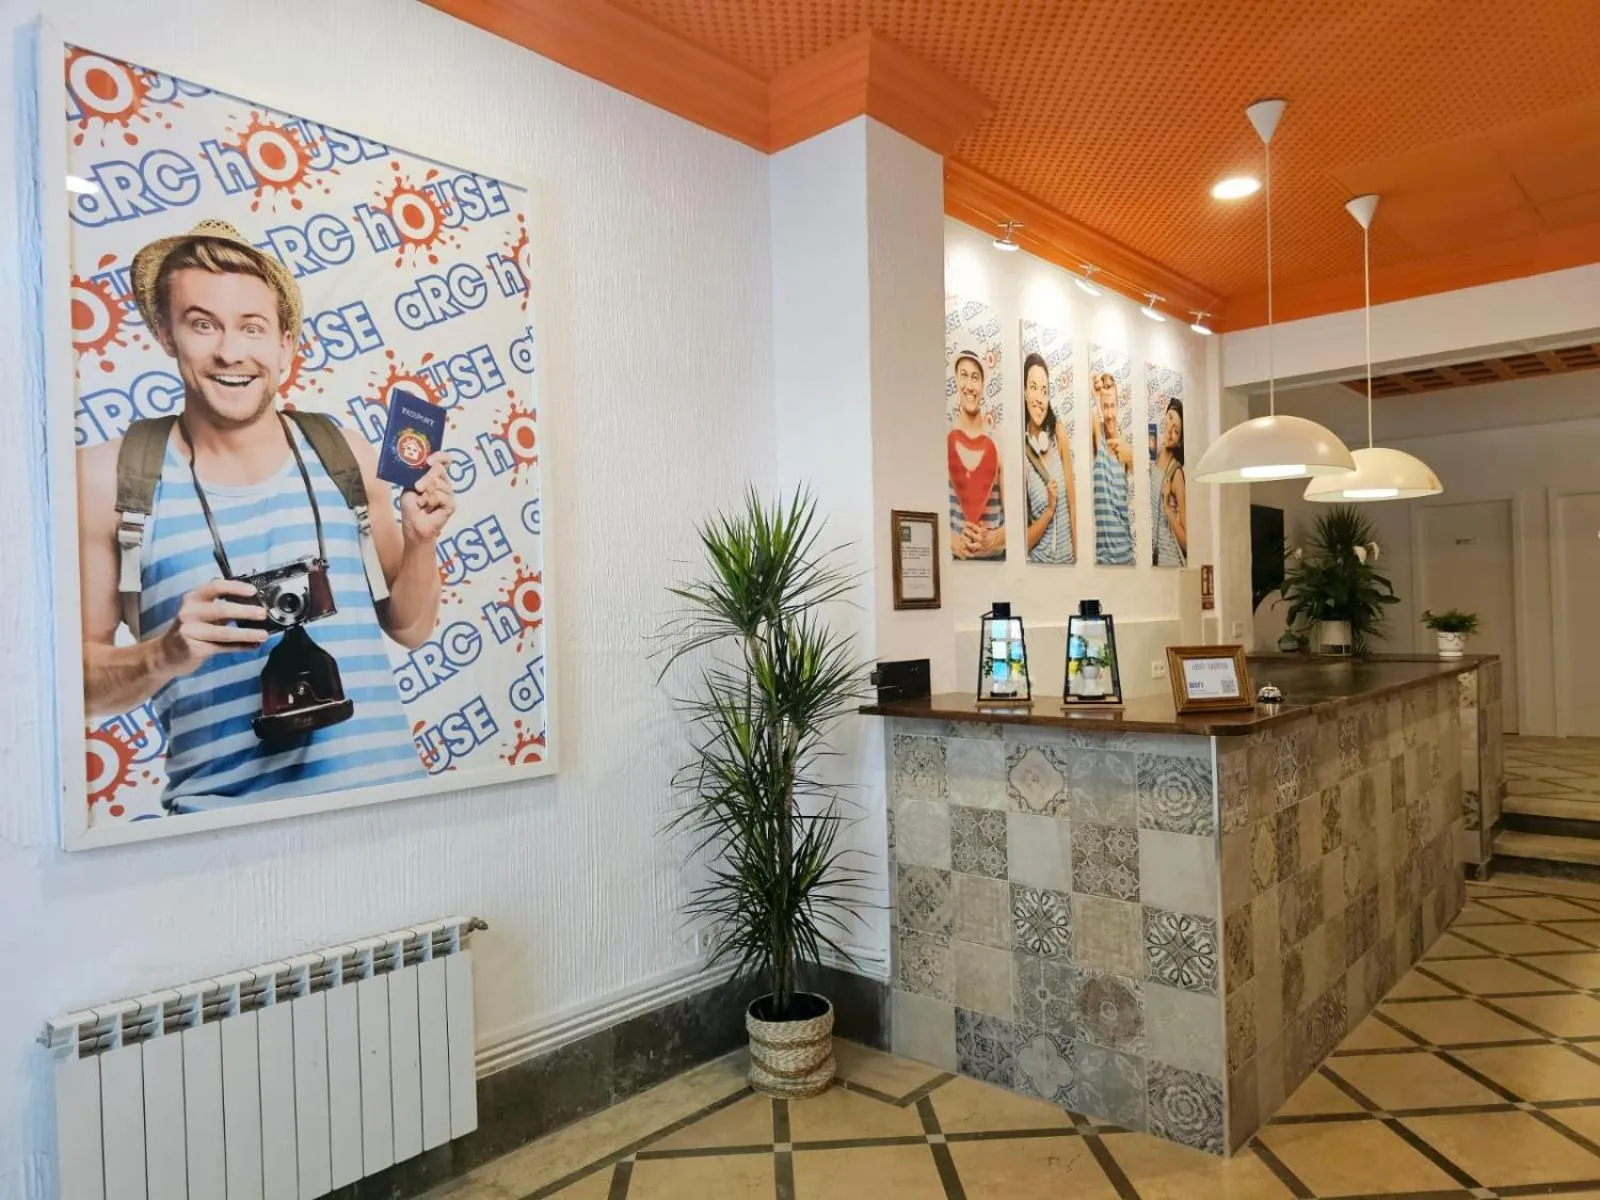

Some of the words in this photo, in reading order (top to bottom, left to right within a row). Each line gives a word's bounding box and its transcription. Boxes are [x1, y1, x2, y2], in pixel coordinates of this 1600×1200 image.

[69, 149, 202, 228] aRC
[353, 173, 510, 254] hOUSE
[395, 262, 487, 331] aRC
[401, 406, 435, 427] PASSPORT
[392, 620, 483, 705] aRC
